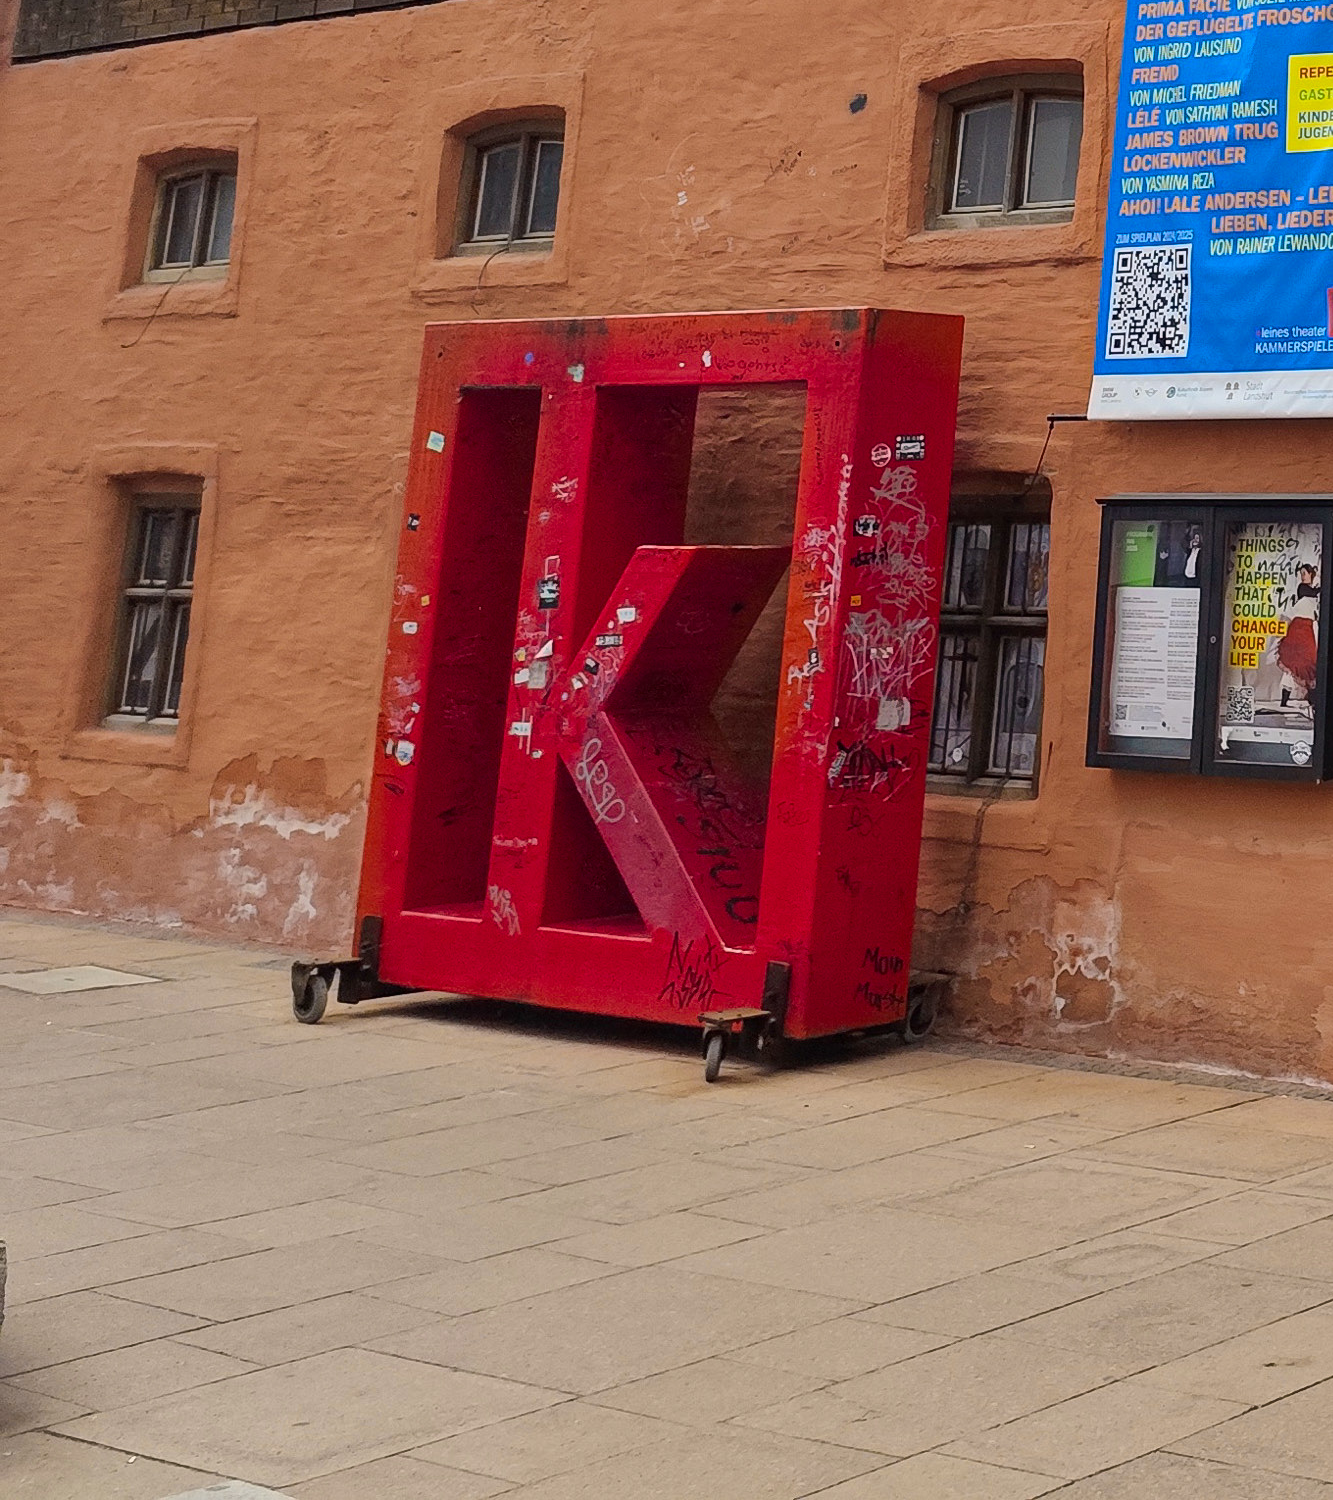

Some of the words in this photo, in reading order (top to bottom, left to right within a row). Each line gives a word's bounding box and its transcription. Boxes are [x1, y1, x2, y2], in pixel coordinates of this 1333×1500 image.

[1138, 0, 1185, 20] PRIMA
[1136, 23, 1163, 41] DER
[1167, 11, 1255, 37] GEFLÜGELTE
[1134, 46, 1155, 63] VON
[1158, 42, 1191, 61] INGRID
[1194, 37, 1241, 58] LAUSUND
[1131, 64, 1179, 84] FREMD
[1130, 89, 1150, 107] VON
[1152, 85, 1186, 104] MICHEL
[1189, 80, 1242, 100] FRIEDMAN
[1127, 106, 1161, 128] LÉLÉ
[1165, 108, 1185, 125] VON
[1186, 104, 1228, 123] SATHYAN
[1231, 99, 1278, 119] RAMESH
[1125, 131, 1173, 151] JAMES
[1179, 126, 1228, 145] BROWN
[1234, 122, 1278, 139] TRUG
[1123, 147, 1246, 173] LOCKENWICKLER
[1121, 177, 1143, 195] VON
[1145, 174, 1188, 193] YASMINA
[1193, 172, 1215, 189] REZA
[1119, 197, 1161, 217] AHOI!
[1164, 195, 1200, 213] LALE
[1204, 190, 1291, 211] ANDERSEN
[1211, 214, 1272, 233] LIEBEN,
[1130, 232, 1161, 243] SPIELPLAN
[1210, 238, 1233, 256] VON
[1236, 236, 1275, 254] RAINER
[1292, 326, 1327, 338] theater
[1239, 538, 1285, 552] THINGS
[1237, 555, 1252, 568] TO
[1235, 571, 1287, 586] HAPPEN
[1235, 587, 1266, 601] THAT
[1233, 603, 1276, 618] COULD
[1232, 620, 1286, 634] CHANGE
[1231, 635, 1265, 650] YOUR
[1229, 652, 1257, 667] LIFE
